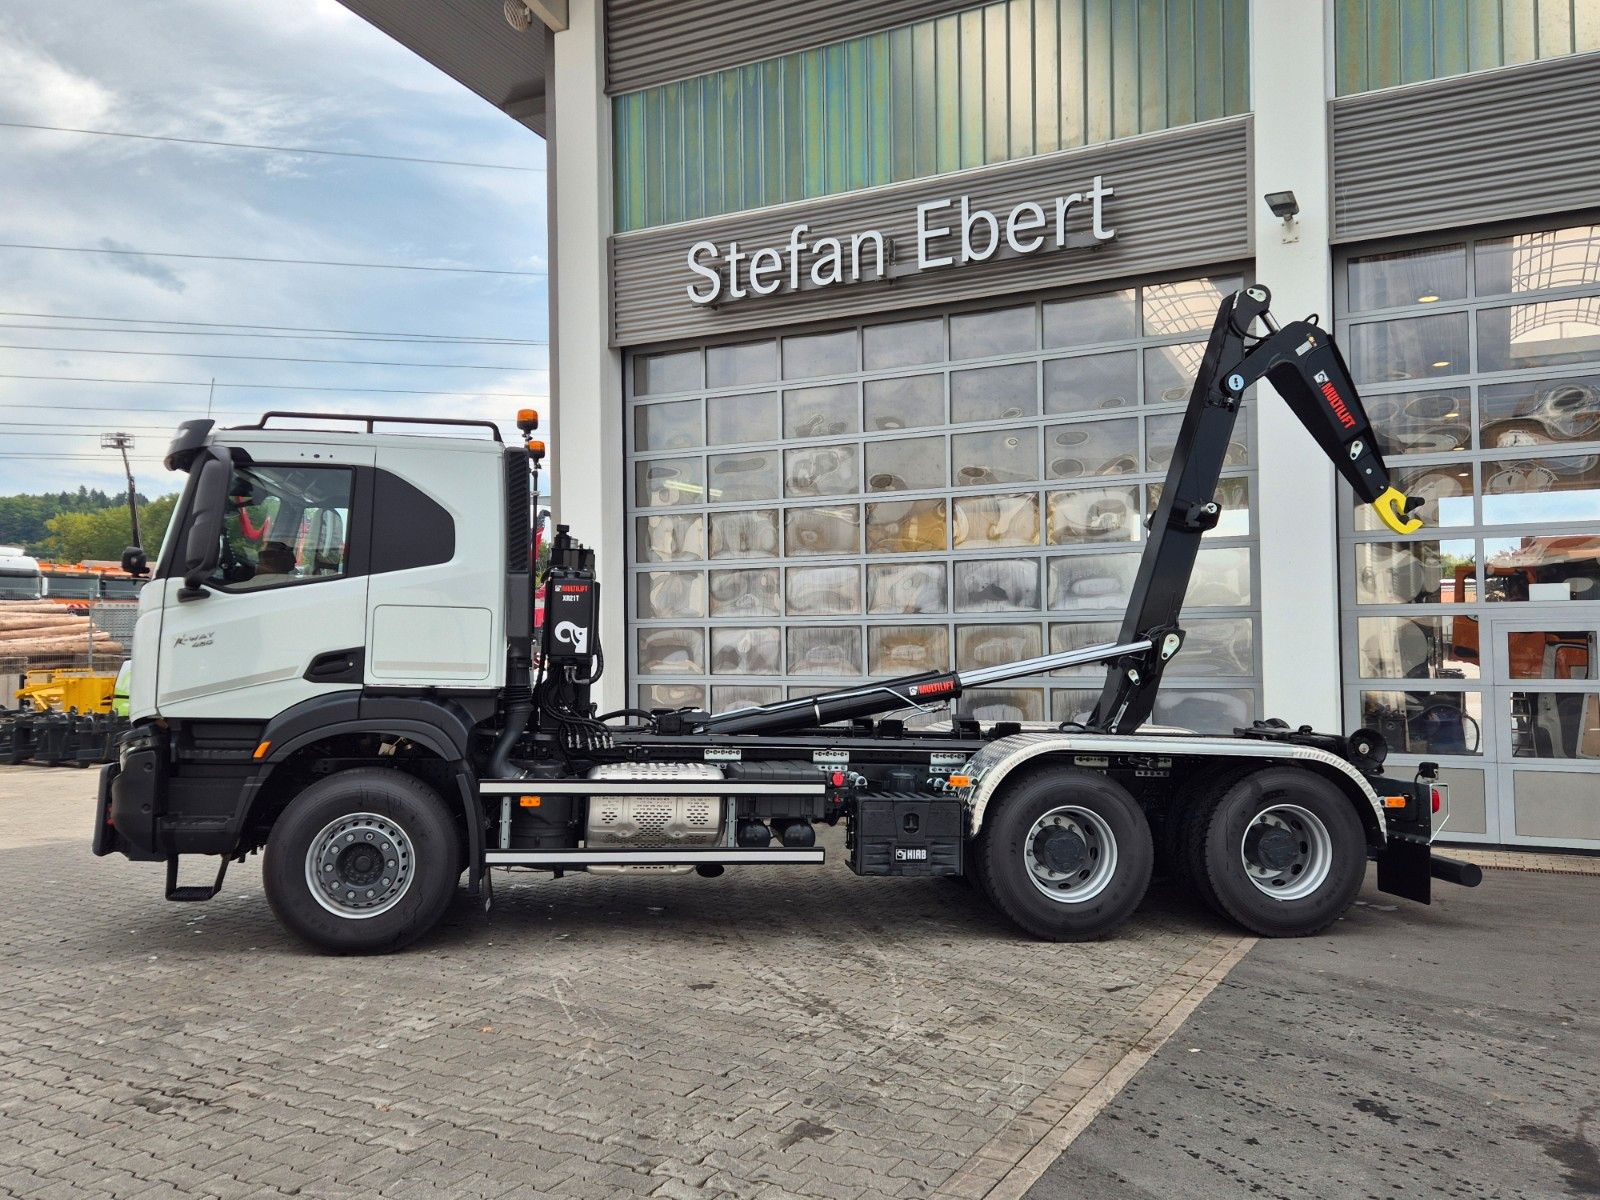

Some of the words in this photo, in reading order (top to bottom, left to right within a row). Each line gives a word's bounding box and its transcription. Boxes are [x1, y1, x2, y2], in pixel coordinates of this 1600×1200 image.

[686, 224, 886, 304] Stefan
[917, 175, 1116, 271] Ebert
[1321, 381, 1356, 429] MULTILIFT
[918, 680, 955, 695] MULTILIFT
[906, 849, 927, 860] HIAB
